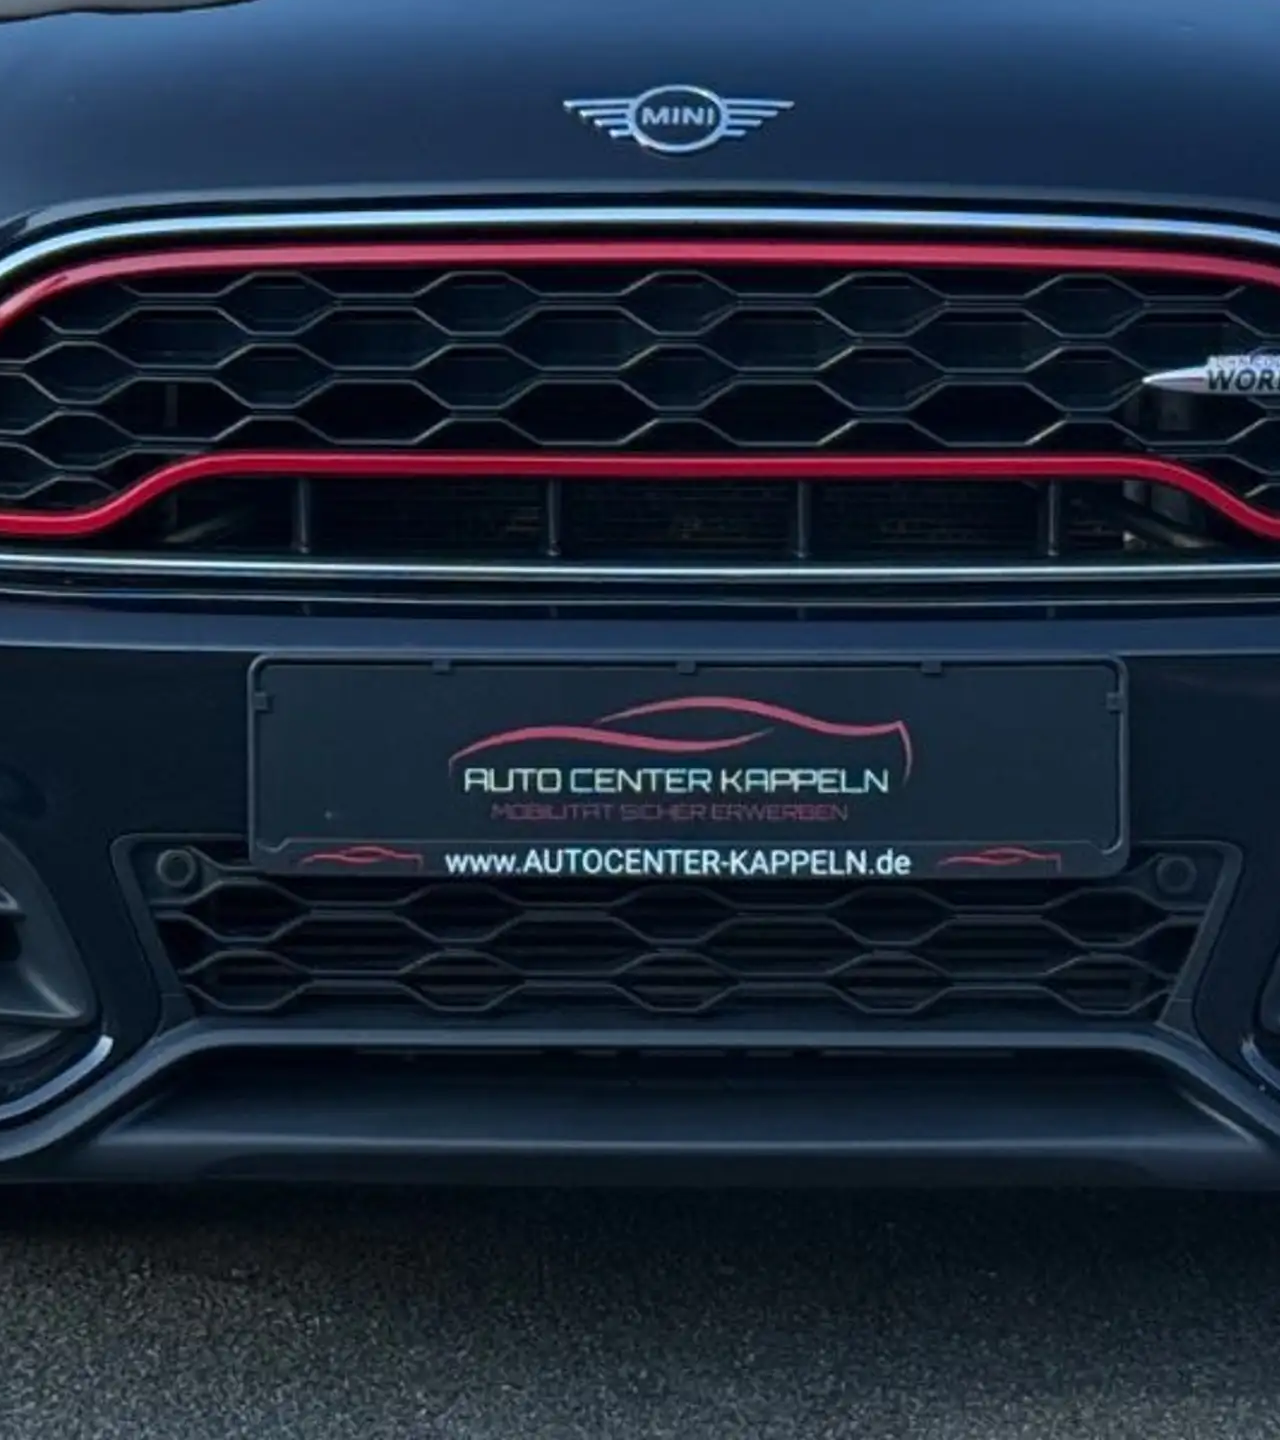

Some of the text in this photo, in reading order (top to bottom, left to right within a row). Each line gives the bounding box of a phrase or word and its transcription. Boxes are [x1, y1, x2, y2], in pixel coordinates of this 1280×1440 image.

[642, 106, 715, 126] MINI
[464, 768, 888, 793] AUTO CENTER KAPPELN
[621, 802, 704, 820] SICHER
[445, 848, 912, 875] www.AUTOCENTER-KAPPELN.de
